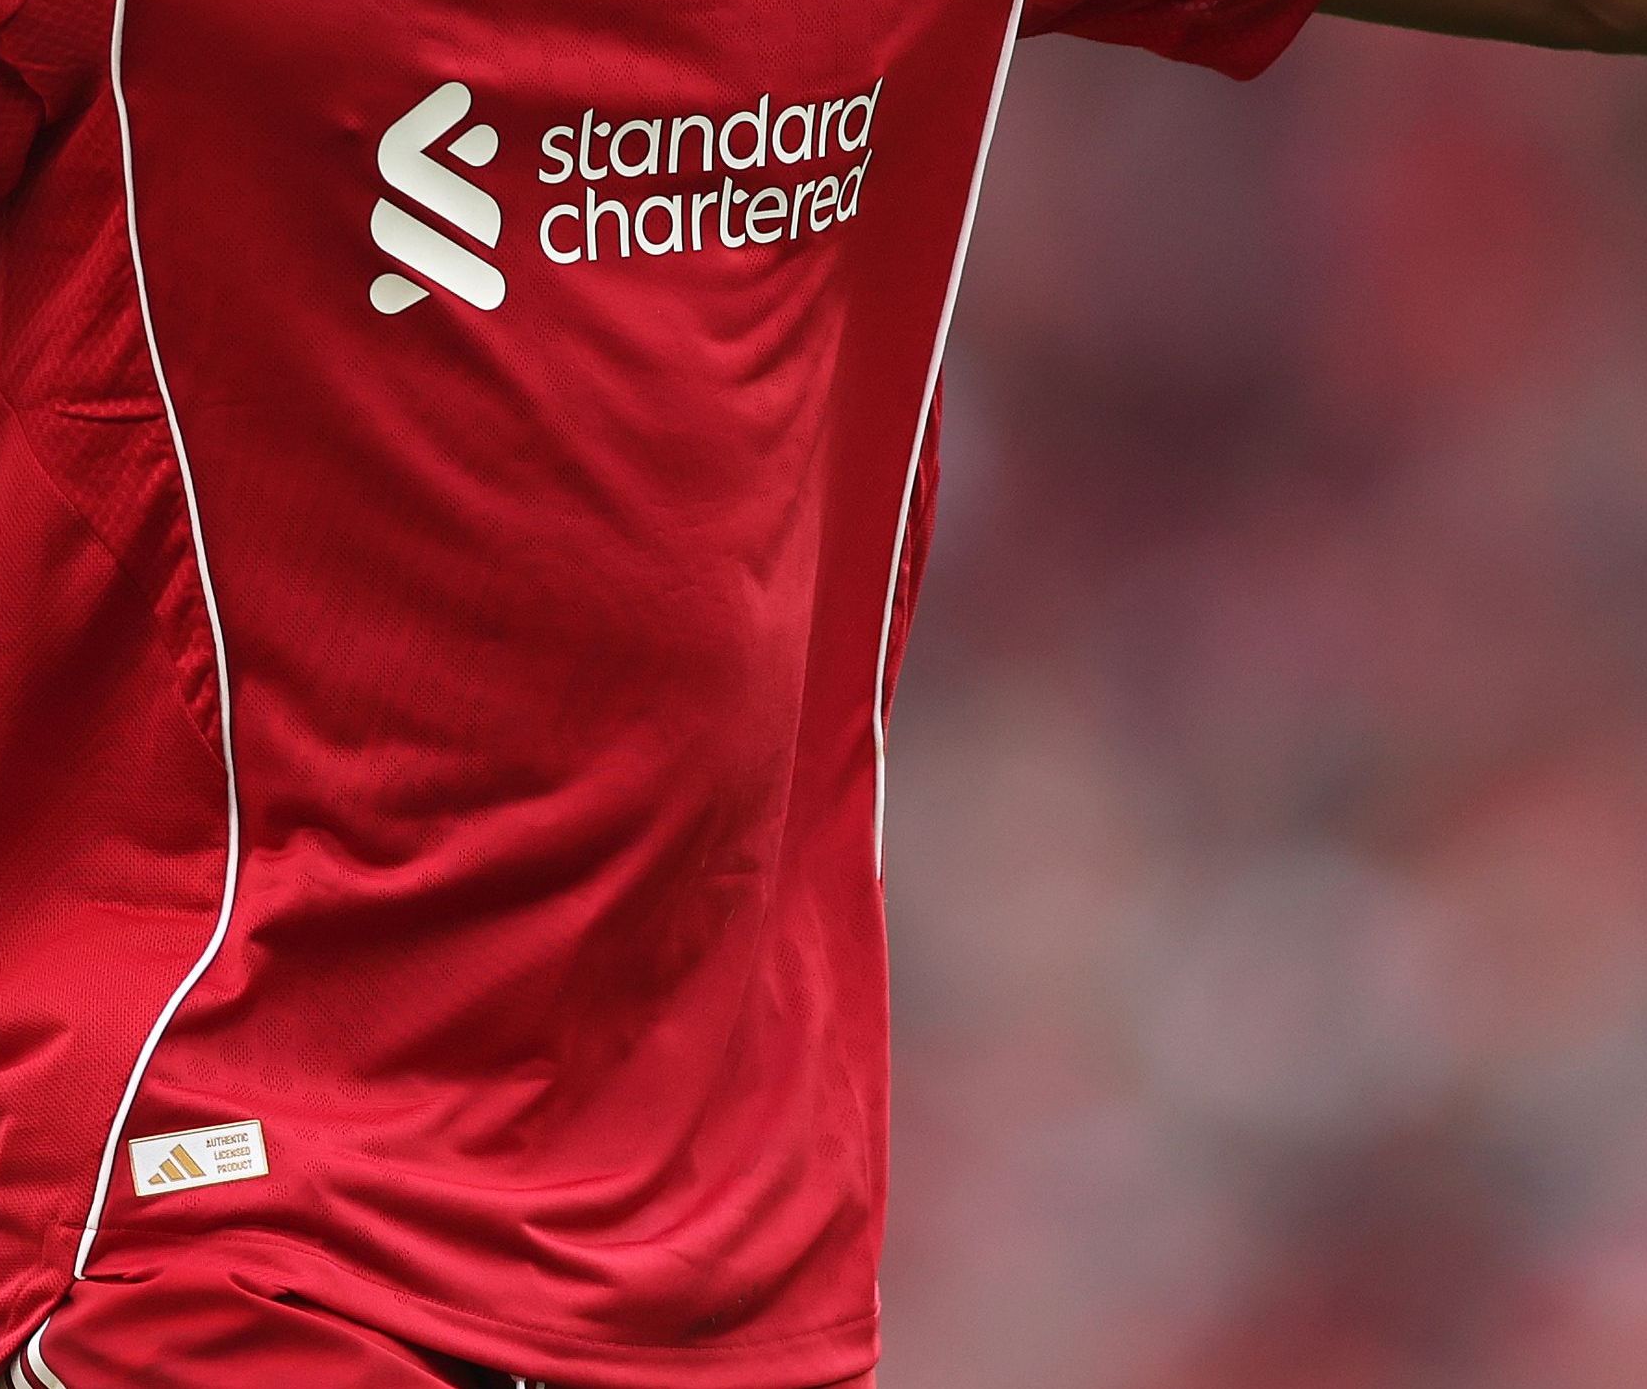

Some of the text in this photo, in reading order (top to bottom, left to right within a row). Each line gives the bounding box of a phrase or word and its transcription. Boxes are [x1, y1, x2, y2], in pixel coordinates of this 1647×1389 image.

[538, 76, 884, 185] standard
[538, 148, 873, 265] chartered
[205, 1132, 249, 1149] AUTHENTIC
[213, 1146, 252, 1161] LICENSED
[216, 1159, 253, 1175] PRODUCT
